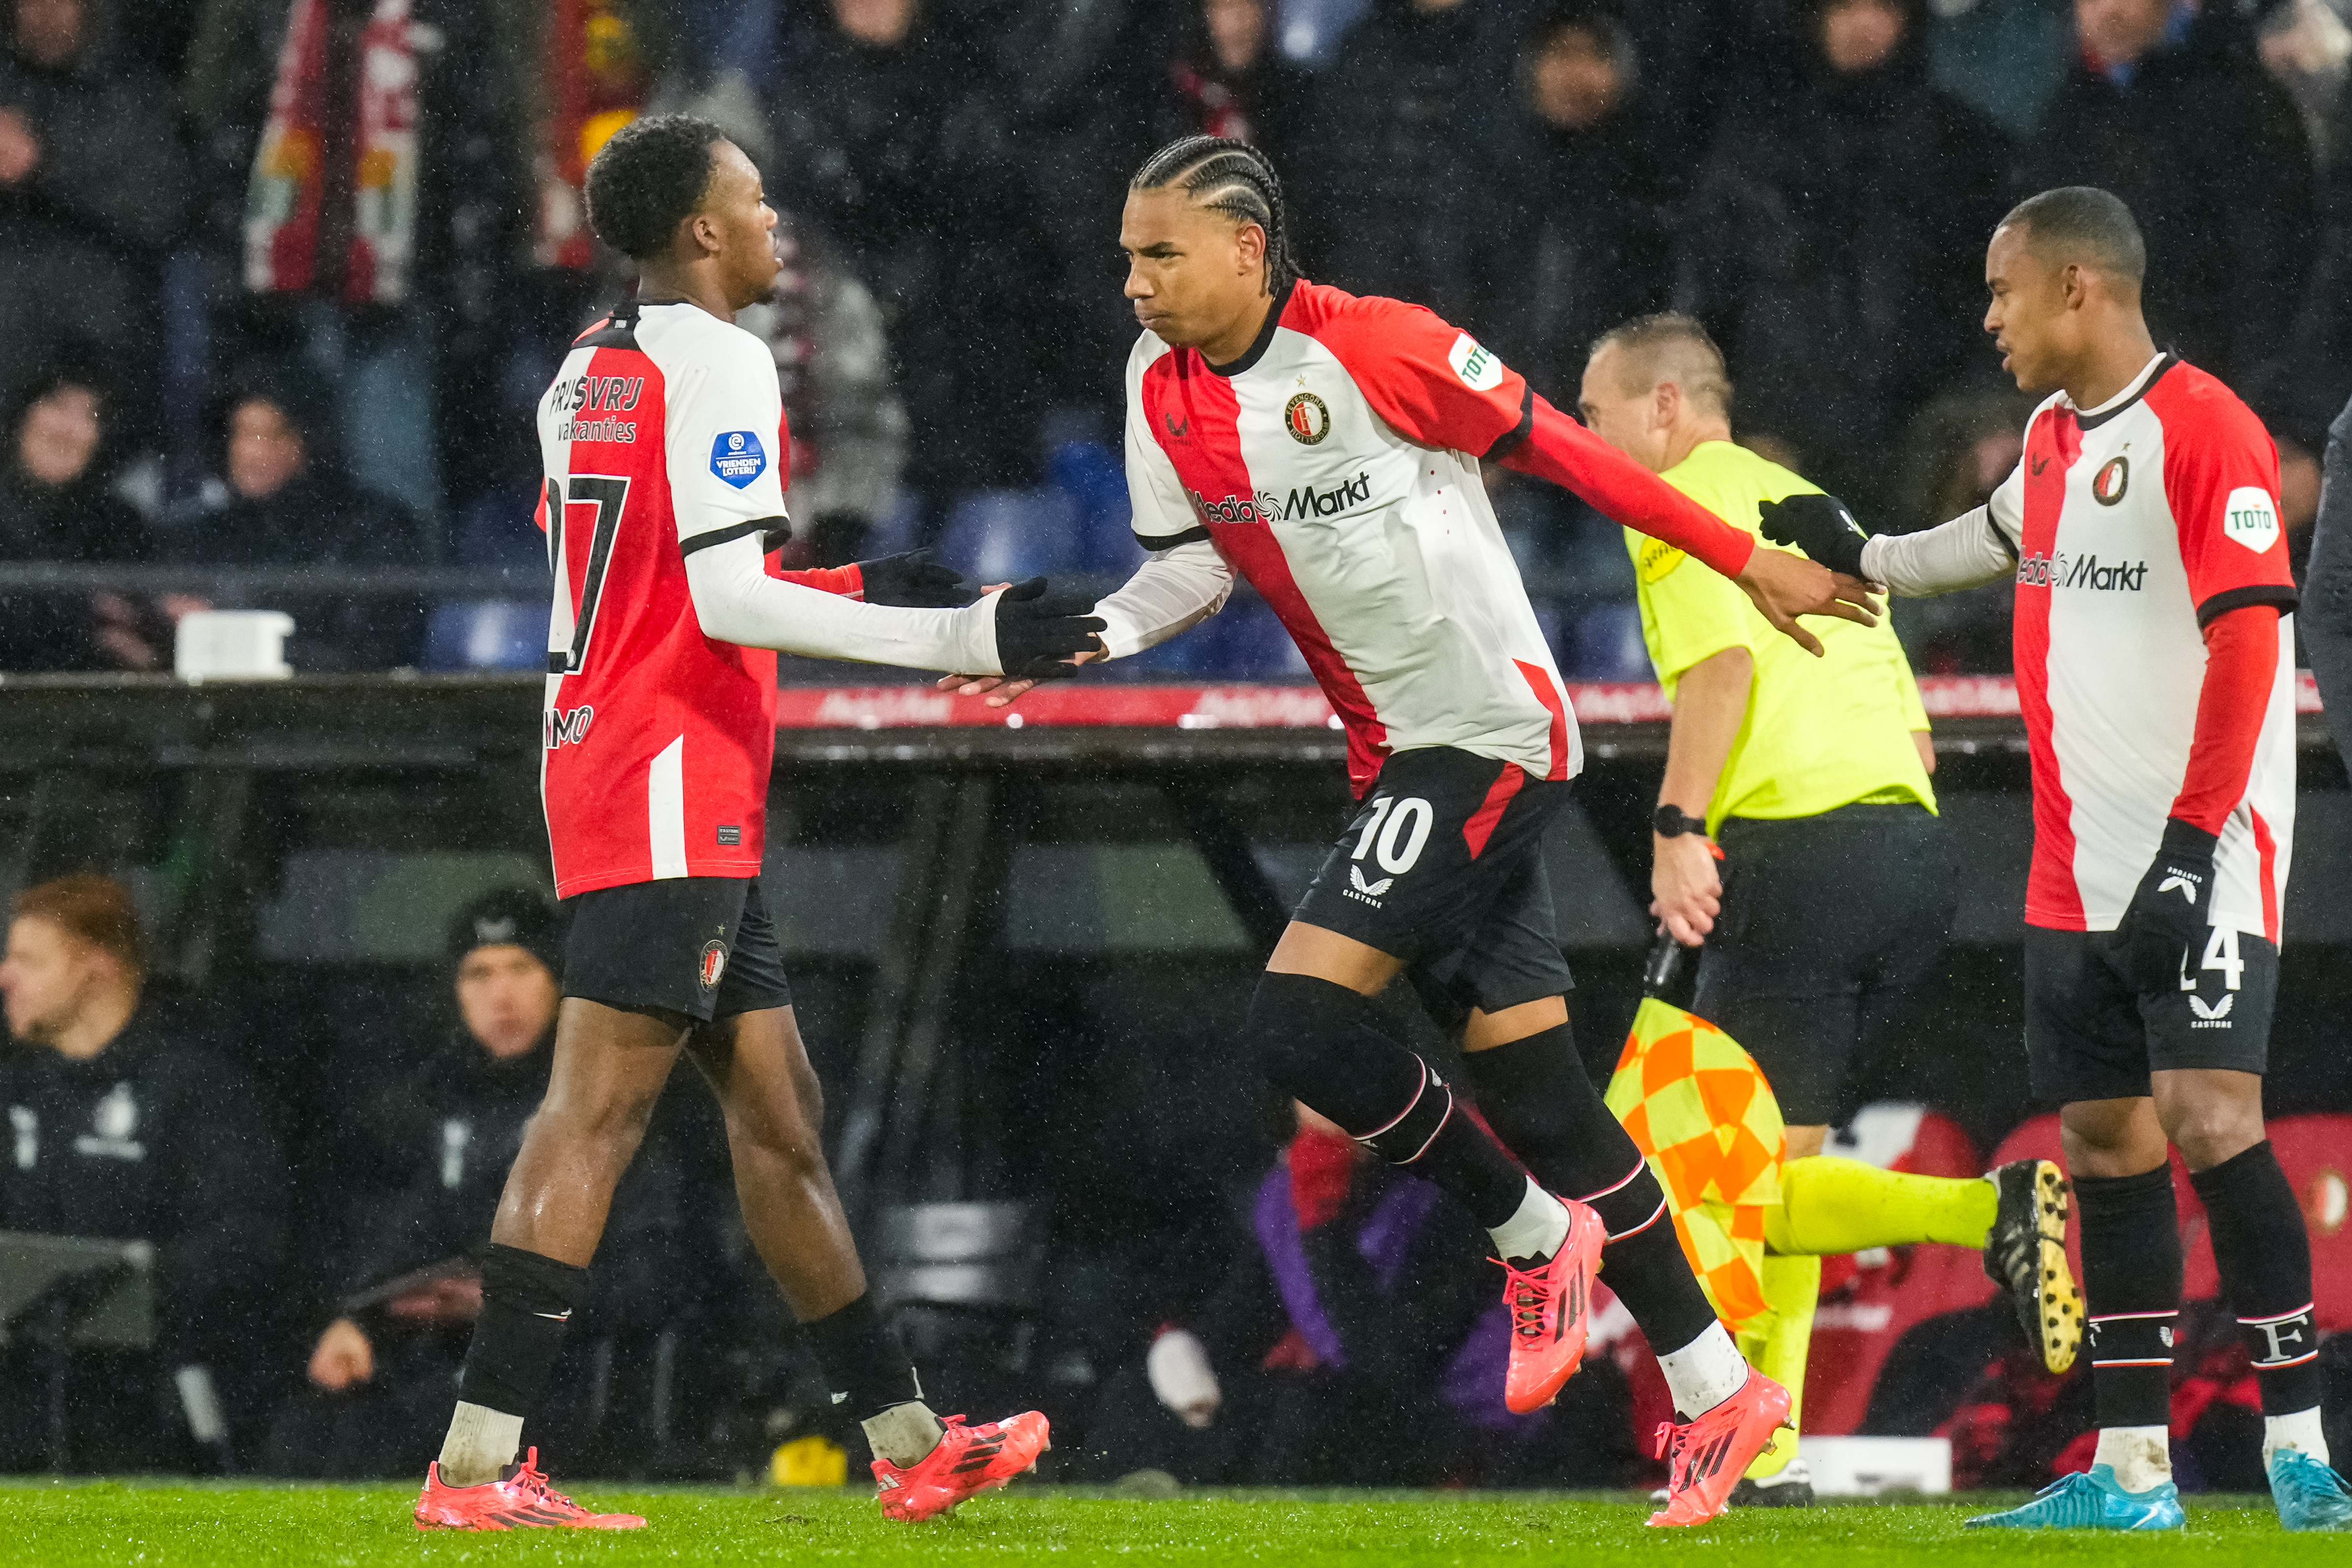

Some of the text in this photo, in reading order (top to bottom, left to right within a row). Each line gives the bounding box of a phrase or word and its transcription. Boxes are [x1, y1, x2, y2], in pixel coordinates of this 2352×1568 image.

[558, 415, 637, 444] vakanties
[716, 458, 761, 469] VRIENDEN
[722, 465, 756, 477] LOTERIJ
[1283, 471, 1370, 521] Markt
[2231, 509, 2271, 530] TOTO
[2066, 553, 2149, 591] Markt
[1350, 796, 1434, 875] 10
[1343, 889, 1383, 909] CASTORE
[2255, 1314, 2308, 1363] F
